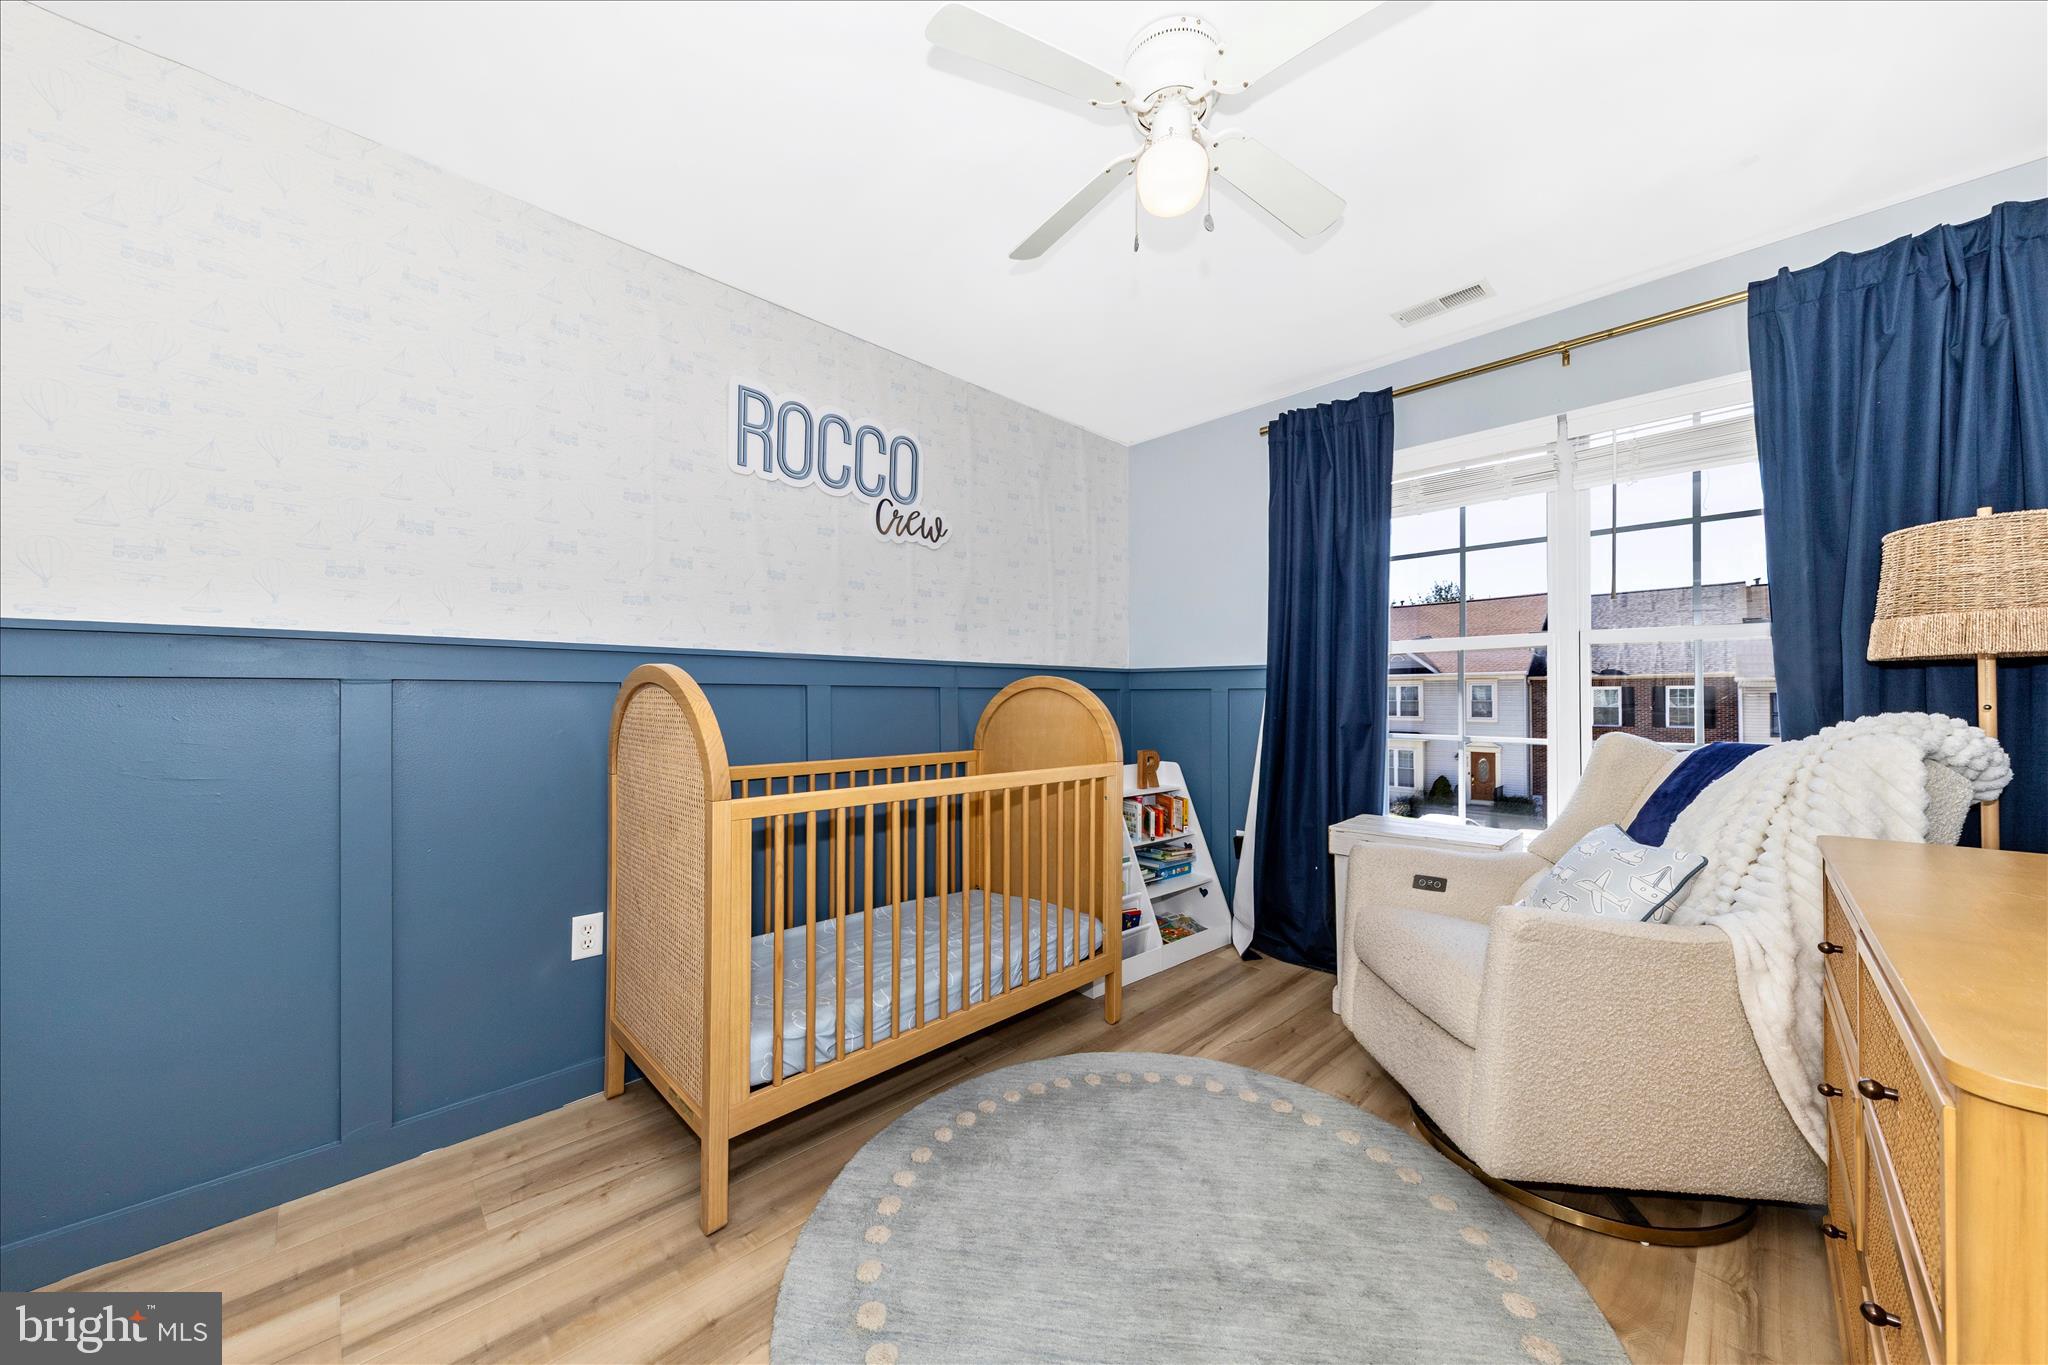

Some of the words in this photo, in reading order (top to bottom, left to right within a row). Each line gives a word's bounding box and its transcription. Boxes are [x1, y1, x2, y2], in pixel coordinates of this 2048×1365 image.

[737, 384, 919, 505] ROCCO
[875, 498, 948, 543] Crew
[1137, 750, 1160, 789] R
